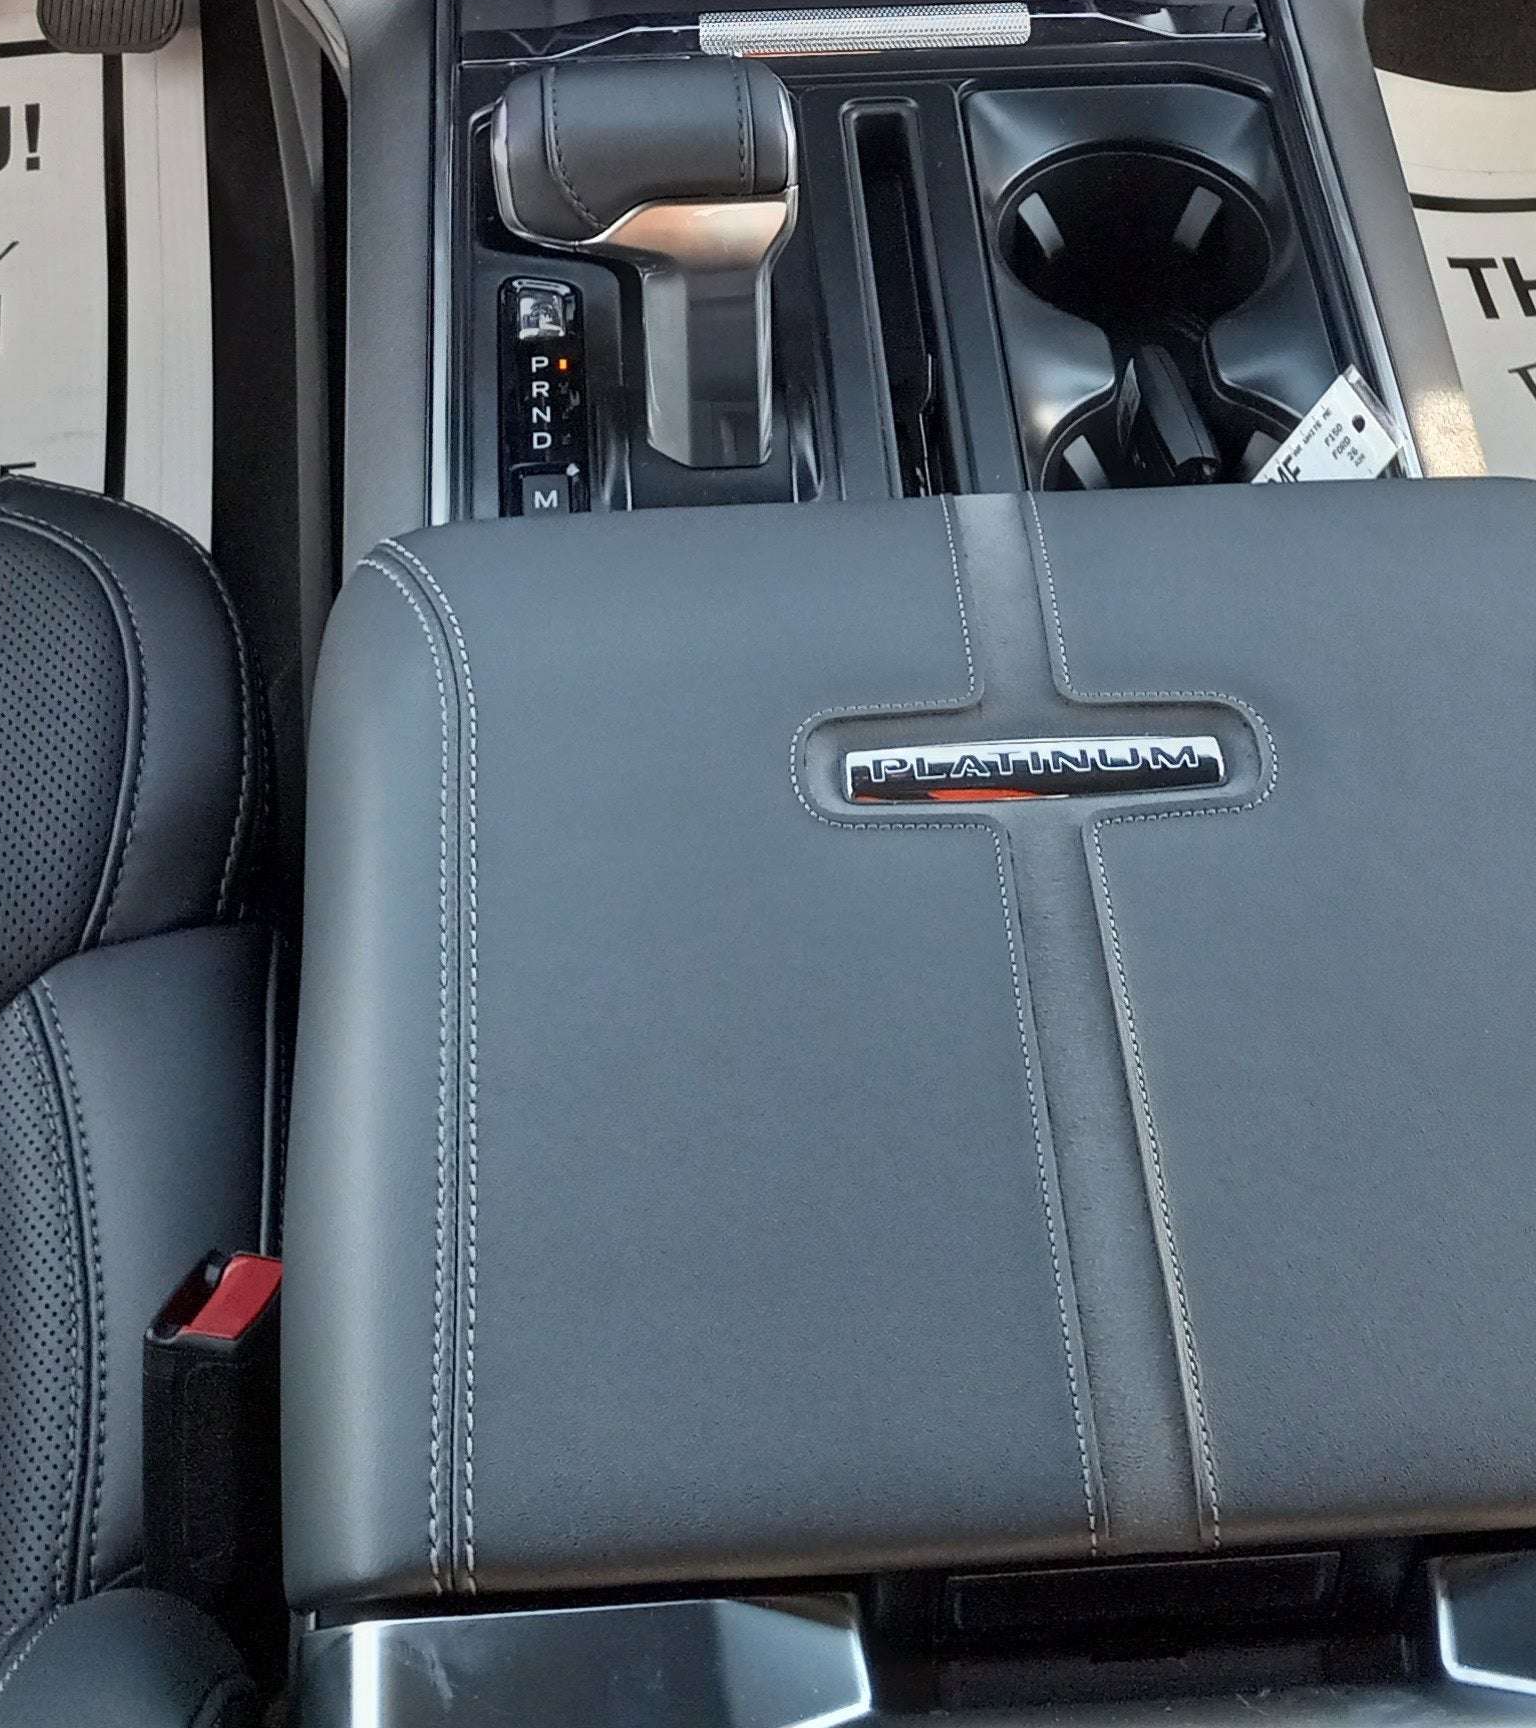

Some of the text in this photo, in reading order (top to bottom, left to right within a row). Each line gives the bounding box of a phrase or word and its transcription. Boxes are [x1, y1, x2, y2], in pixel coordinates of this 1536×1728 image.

[531, 356, 549, 373] P
[531, 381, 550, 398] R
[532, 406, 551, 423] N
[532, 432, 552, 450] D
[1332, 435, 1352, 460] FORD
[534, 490, 559, 509] M
[871, 745, 1201, 784] PLATINUM
